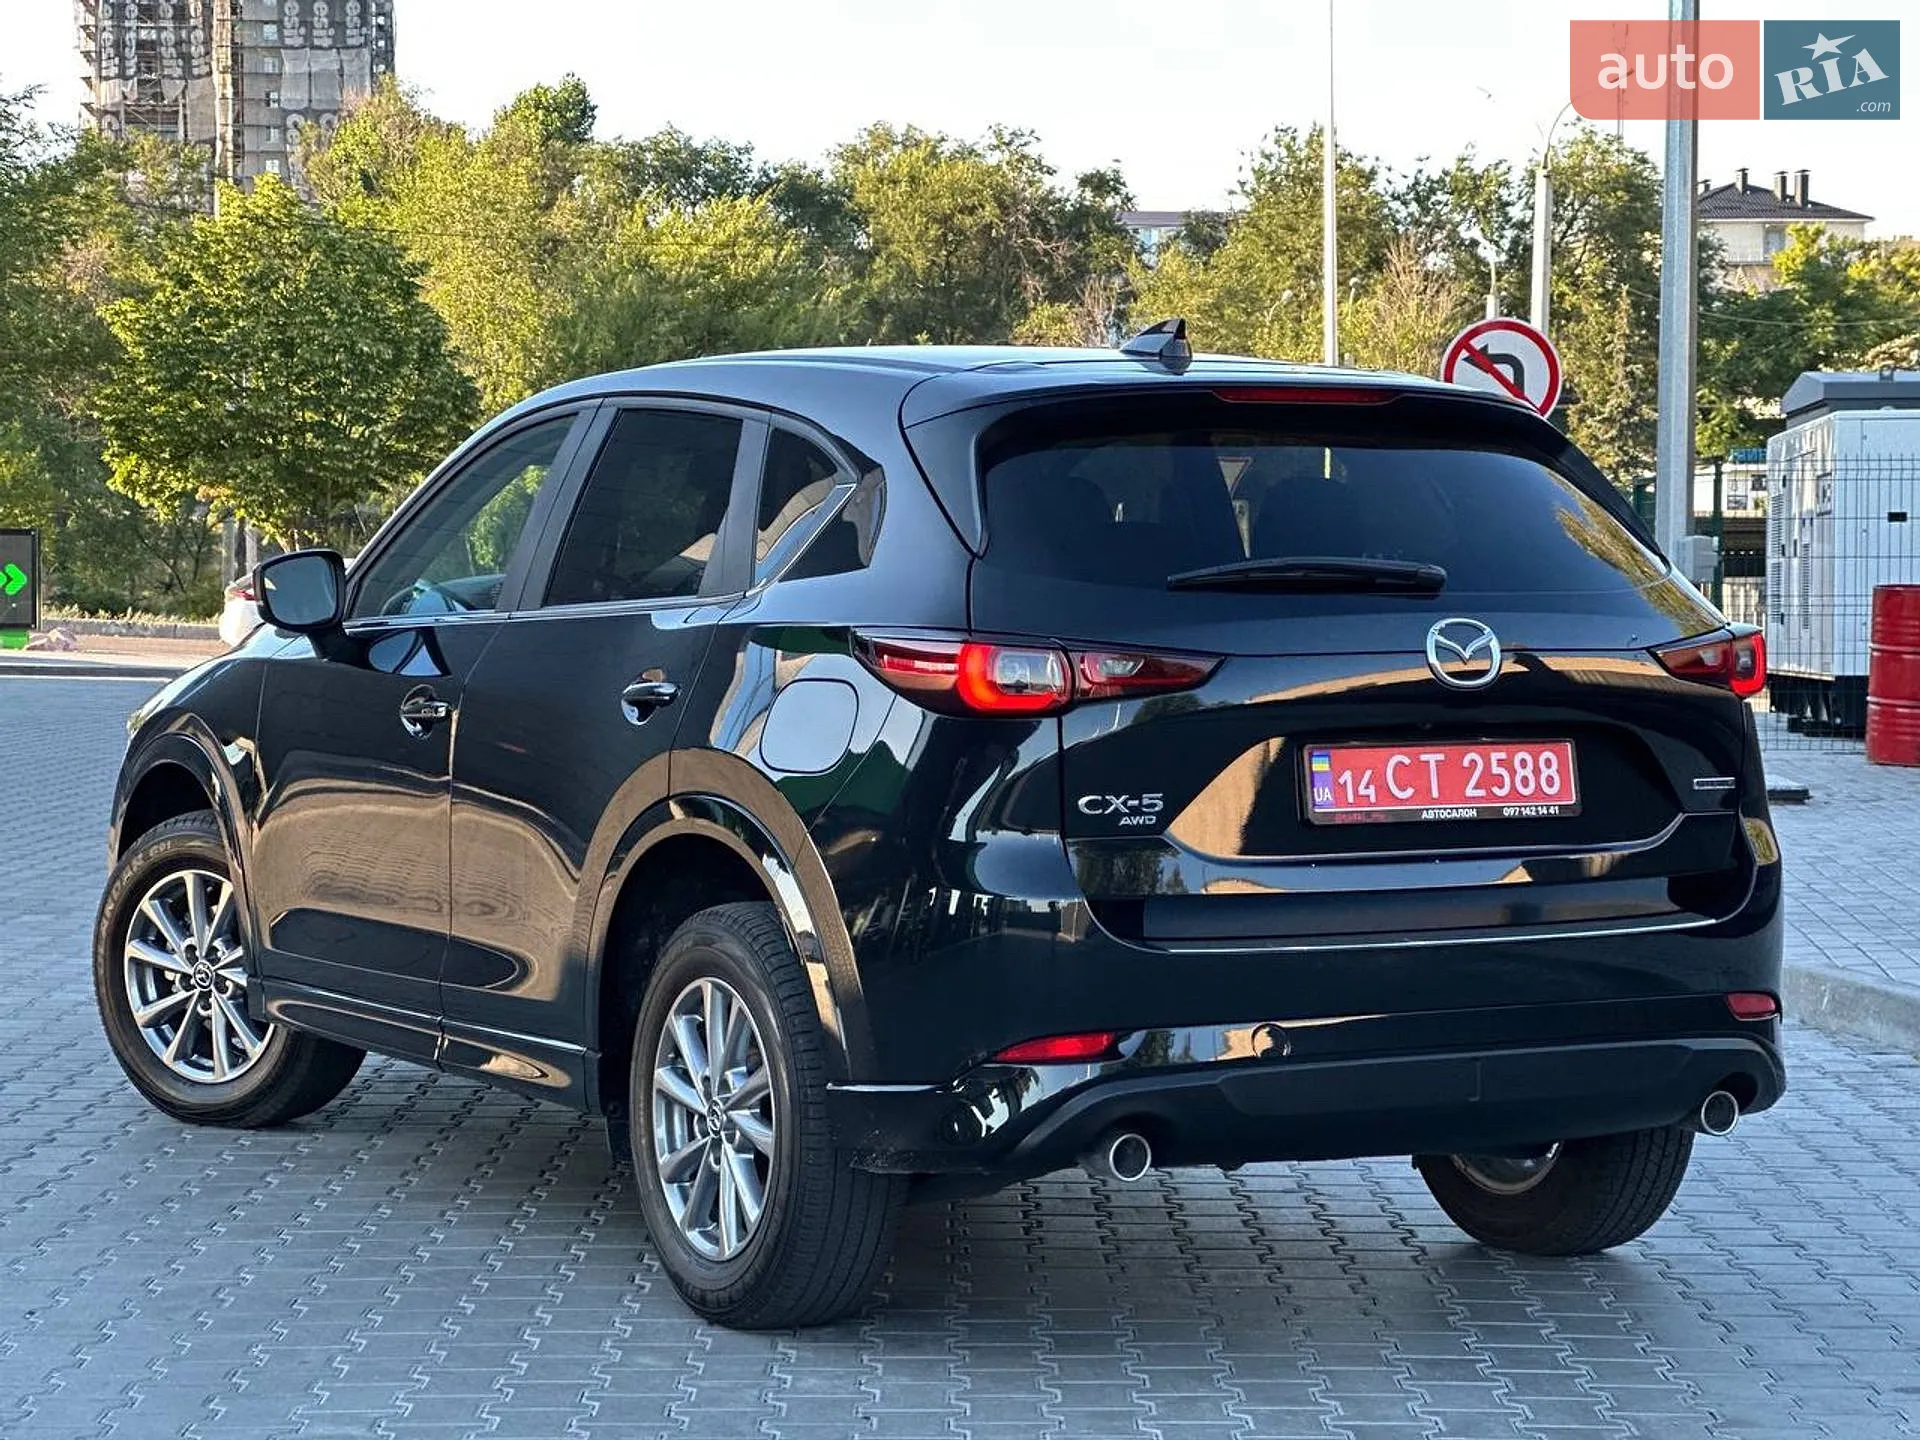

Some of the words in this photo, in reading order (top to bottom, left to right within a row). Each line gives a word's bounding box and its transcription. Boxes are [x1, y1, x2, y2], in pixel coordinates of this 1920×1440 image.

[1338, 769, 1377, 804] 14
[1462, 750, 1561, 797] 2588
[1313, 786, 1333, 802] UA
[1078, 793, 1164, 815] CX-5
[1119, 816, 1157, 826] AWD
